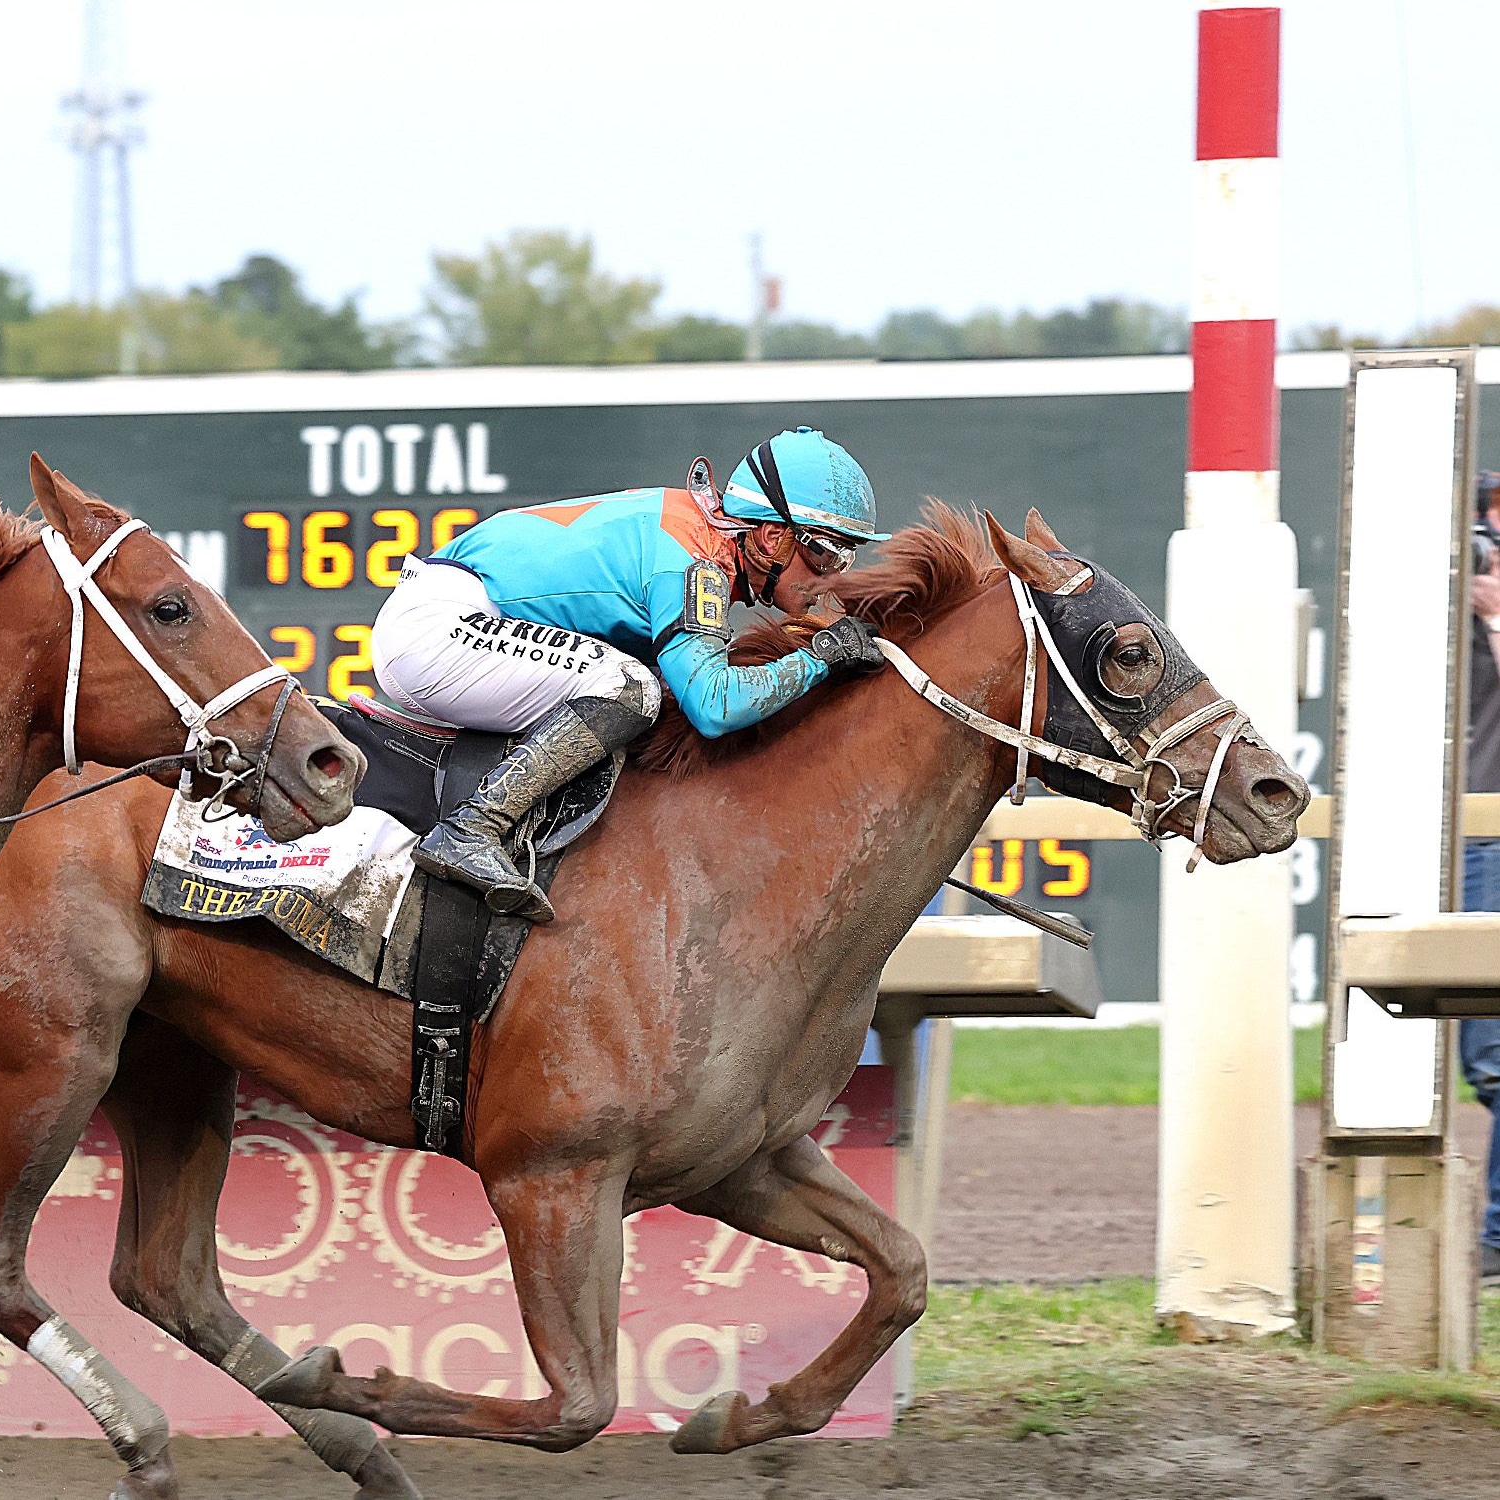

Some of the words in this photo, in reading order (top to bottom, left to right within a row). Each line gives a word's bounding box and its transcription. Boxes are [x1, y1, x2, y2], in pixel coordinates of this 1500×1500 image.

[301, 423, 507, 496] TOTAL
[696, 567, 723, 629] 6
[449, 627, 590, 674] STEAKHOUSE
[511, 620, 605, 660] RUBY'S
[1306, 627, 1325, 699] 1
[189, 850, 277, 873] Pennsylvania
[279, 854, 330, 868] DERBY
[180, 879, 252, 916] THE
[252, 888, 335, 950] PUMA
